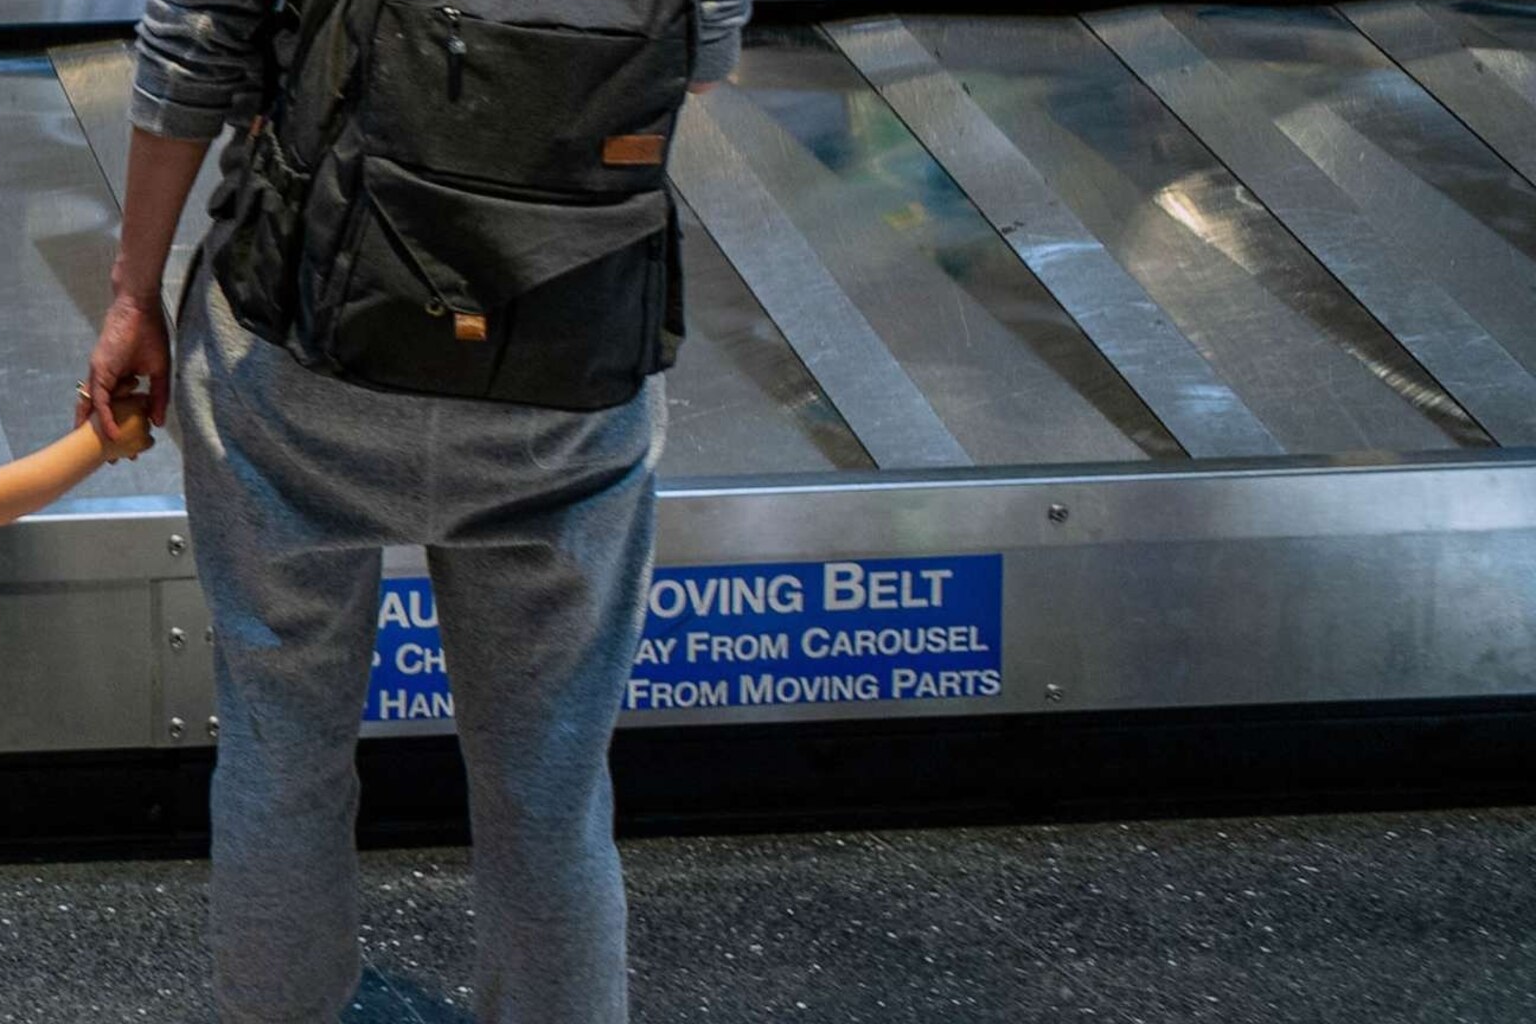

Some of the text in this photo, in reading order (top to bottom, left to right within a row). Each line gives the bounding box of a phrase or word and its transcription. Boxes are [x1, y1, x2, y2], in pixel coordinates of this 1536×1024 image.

[648, 575, 804, 619] OVING
[633, 637, 678, 665] AY
[378, 688, 455, 719] HAN
